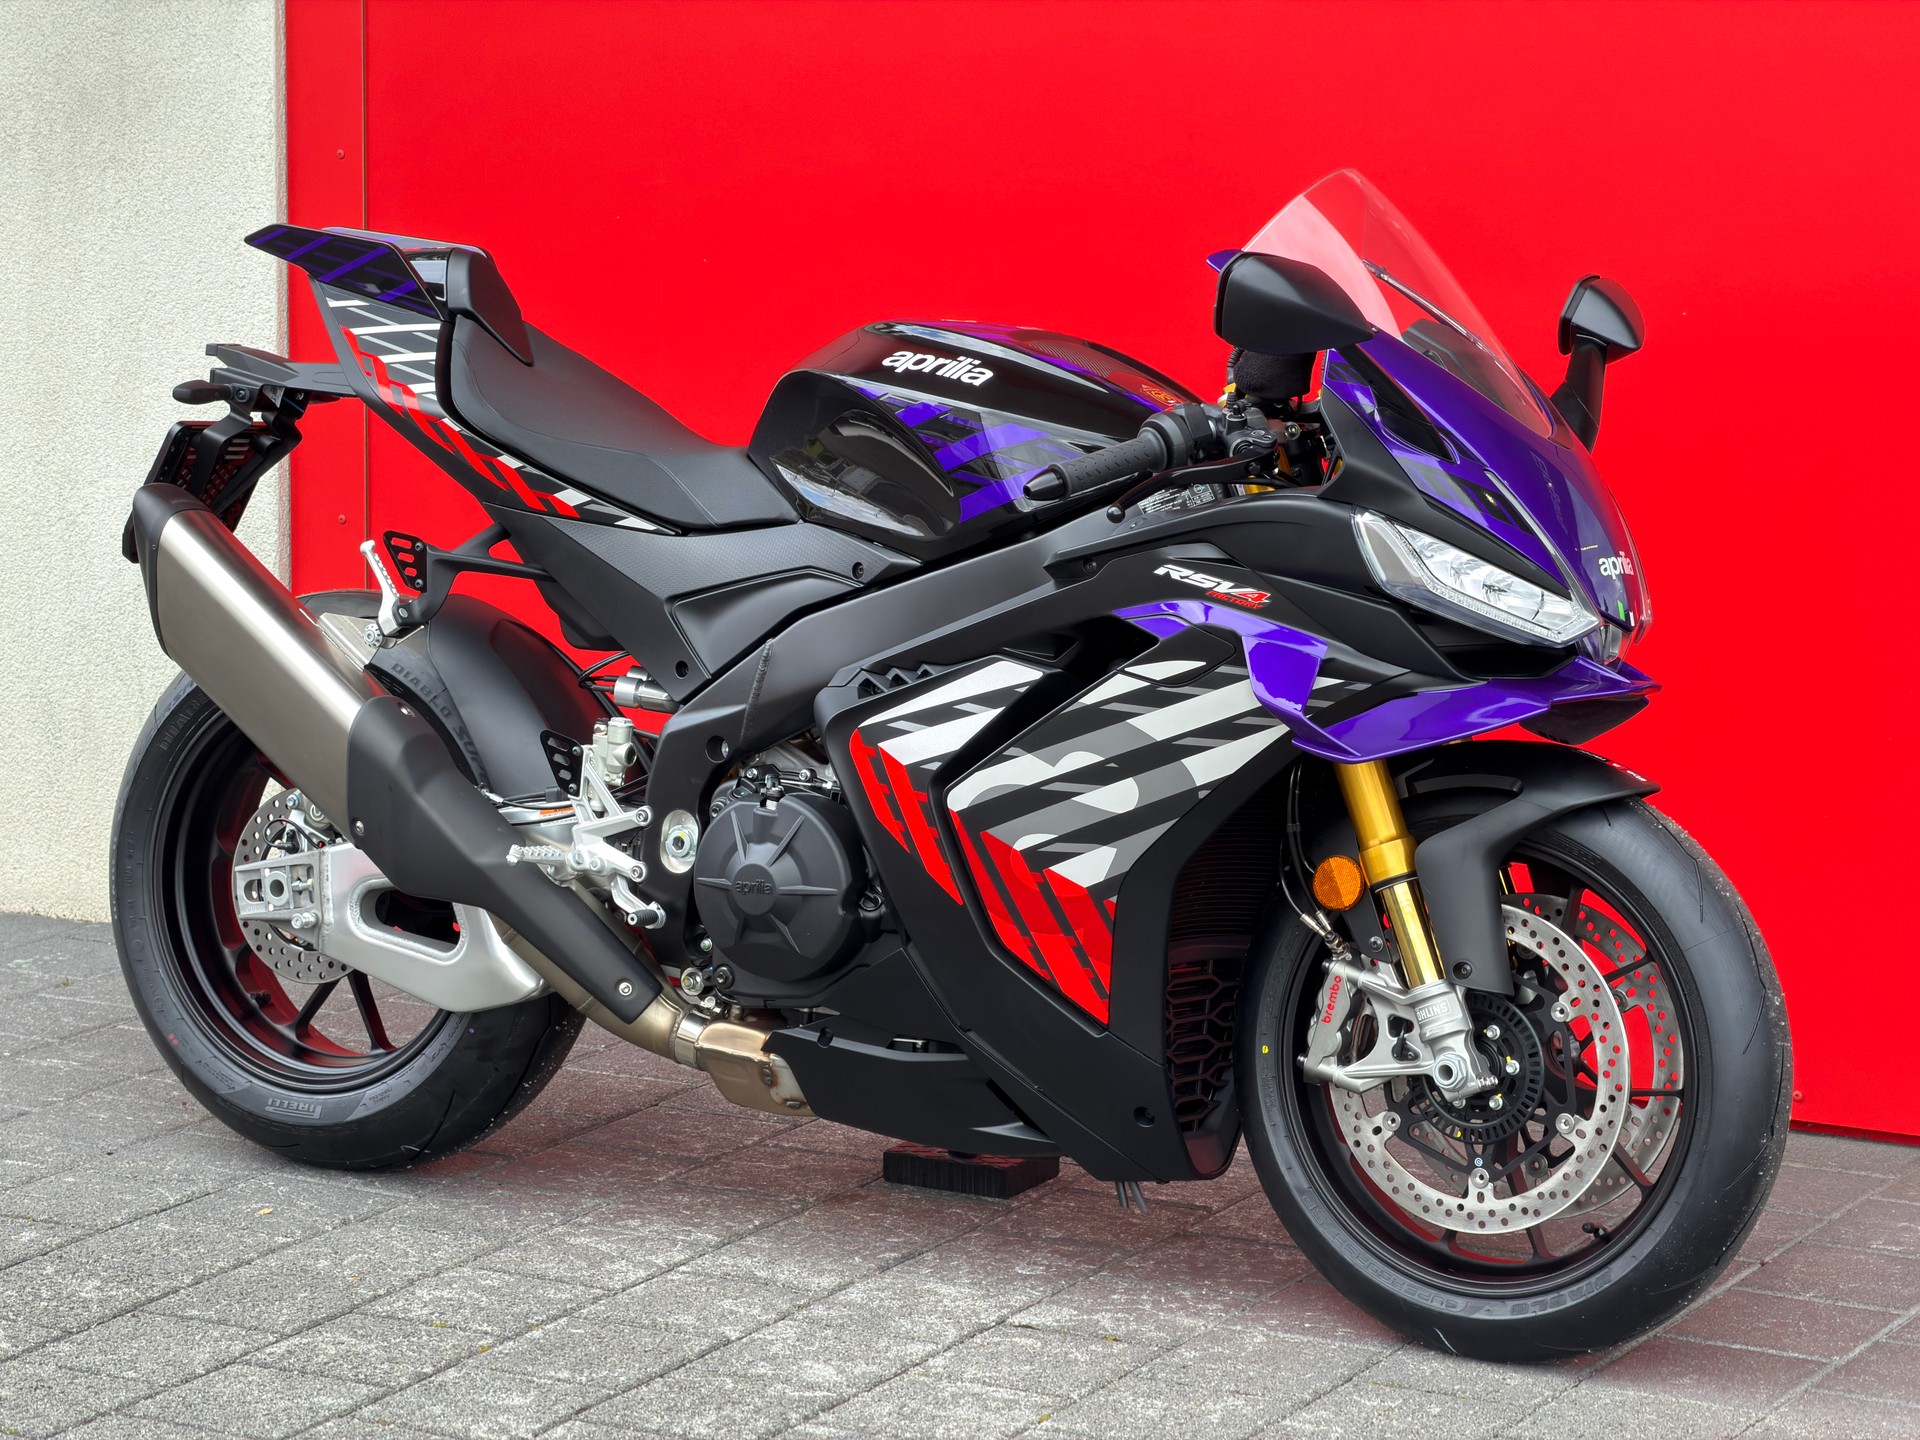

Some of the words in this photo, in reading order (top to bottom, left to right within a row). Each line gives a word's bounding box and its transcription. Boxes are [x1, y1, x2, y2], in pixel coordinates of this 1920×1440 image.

[881, 351, 994, 386] aprilia
[1598, 550, 1634, 580] aprilia
[1153, 564, 1271, 603] RSV4
[1205, 590, 1263, 609] FACTORY
[391, 663, 452, 718] DIABLO
[735, 878, 774, 895] aprilia
[1321, 975, 1342, 1024] brembo
[264, 1097, 323, 1119] PIRELLI
[1511, 1270, 1613, 1316] DIABLO
